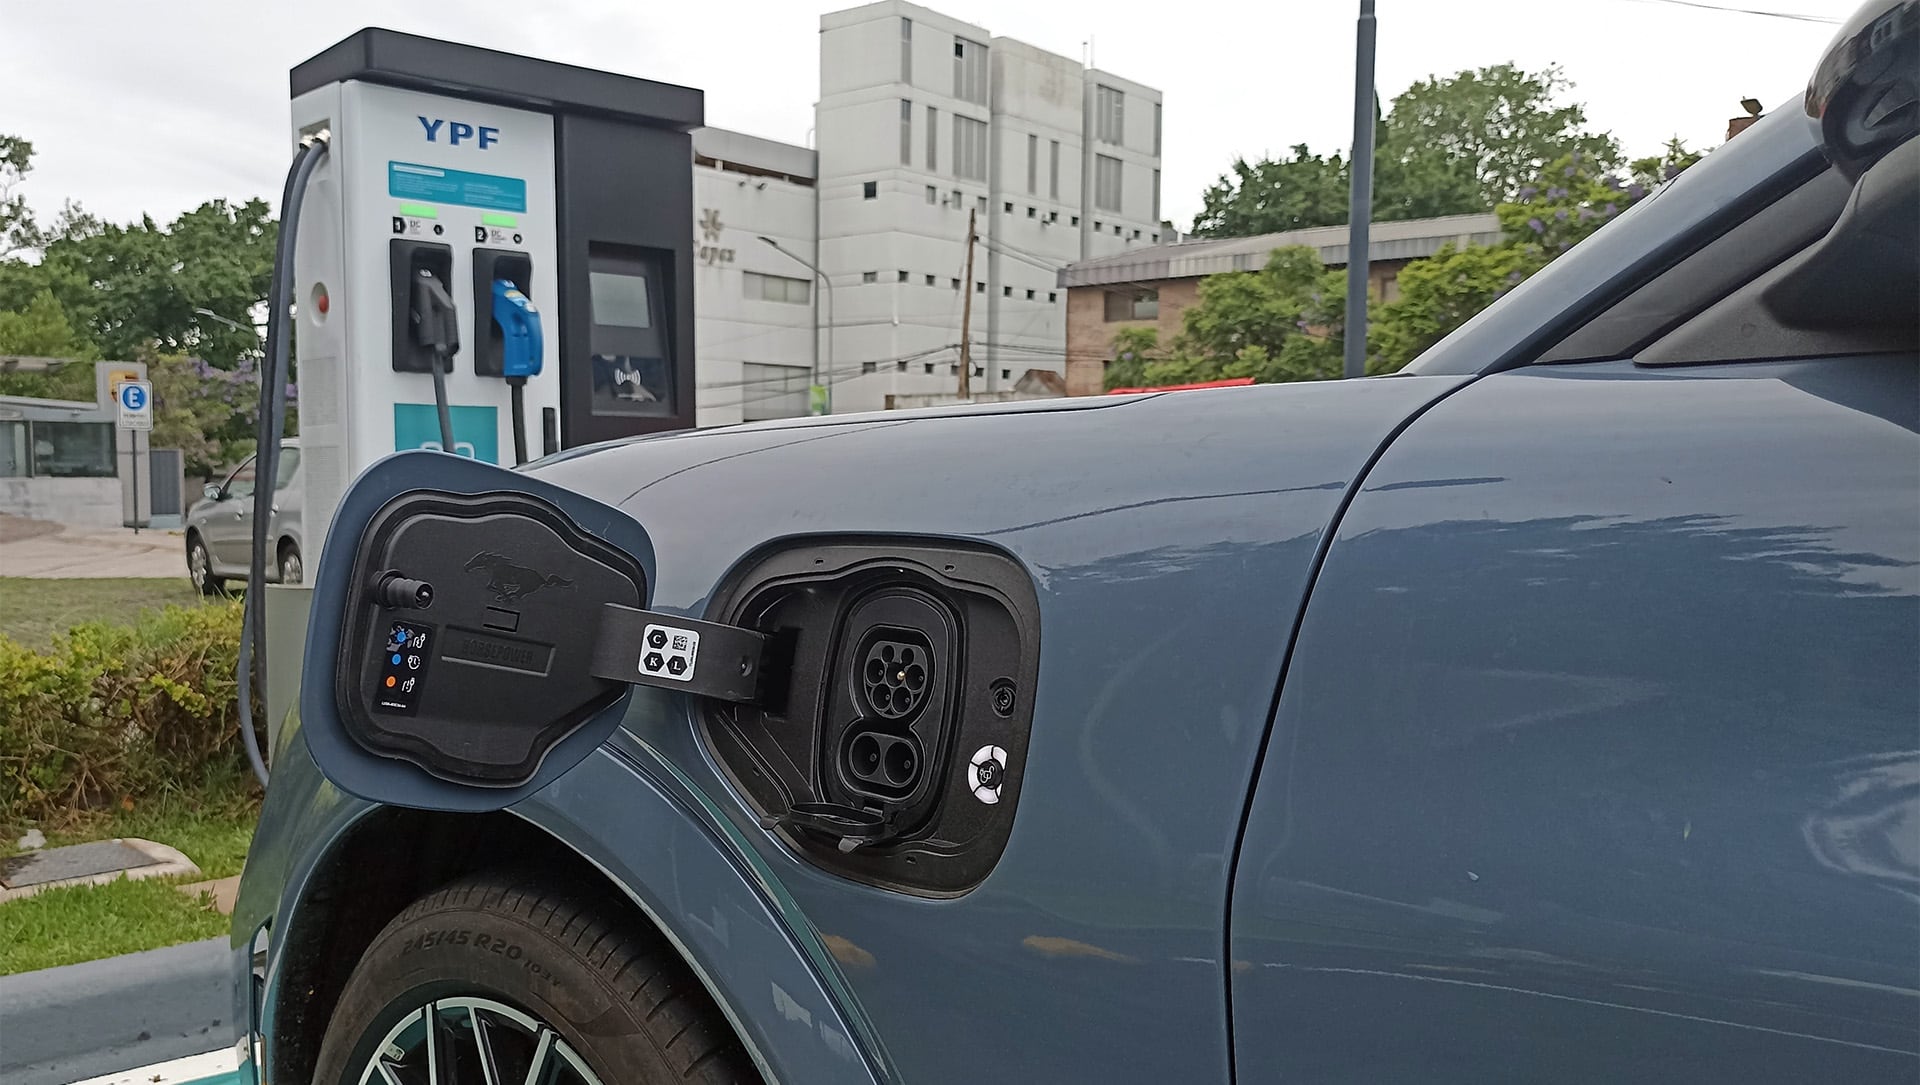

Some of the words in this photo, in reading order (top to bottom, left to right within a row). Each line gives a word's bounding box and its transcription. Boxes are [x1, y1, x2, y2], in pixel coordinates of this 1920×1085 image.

[418, 116, 499, 149] YPF
[130, 388, 141, 408] E
[652, 634, 662, 644] C
[649, 657, 658, 667] K
[673, 661, 681, 671] L
[402, 929, 472, 955] 245/45
[474, 933, 523, 961] R20
